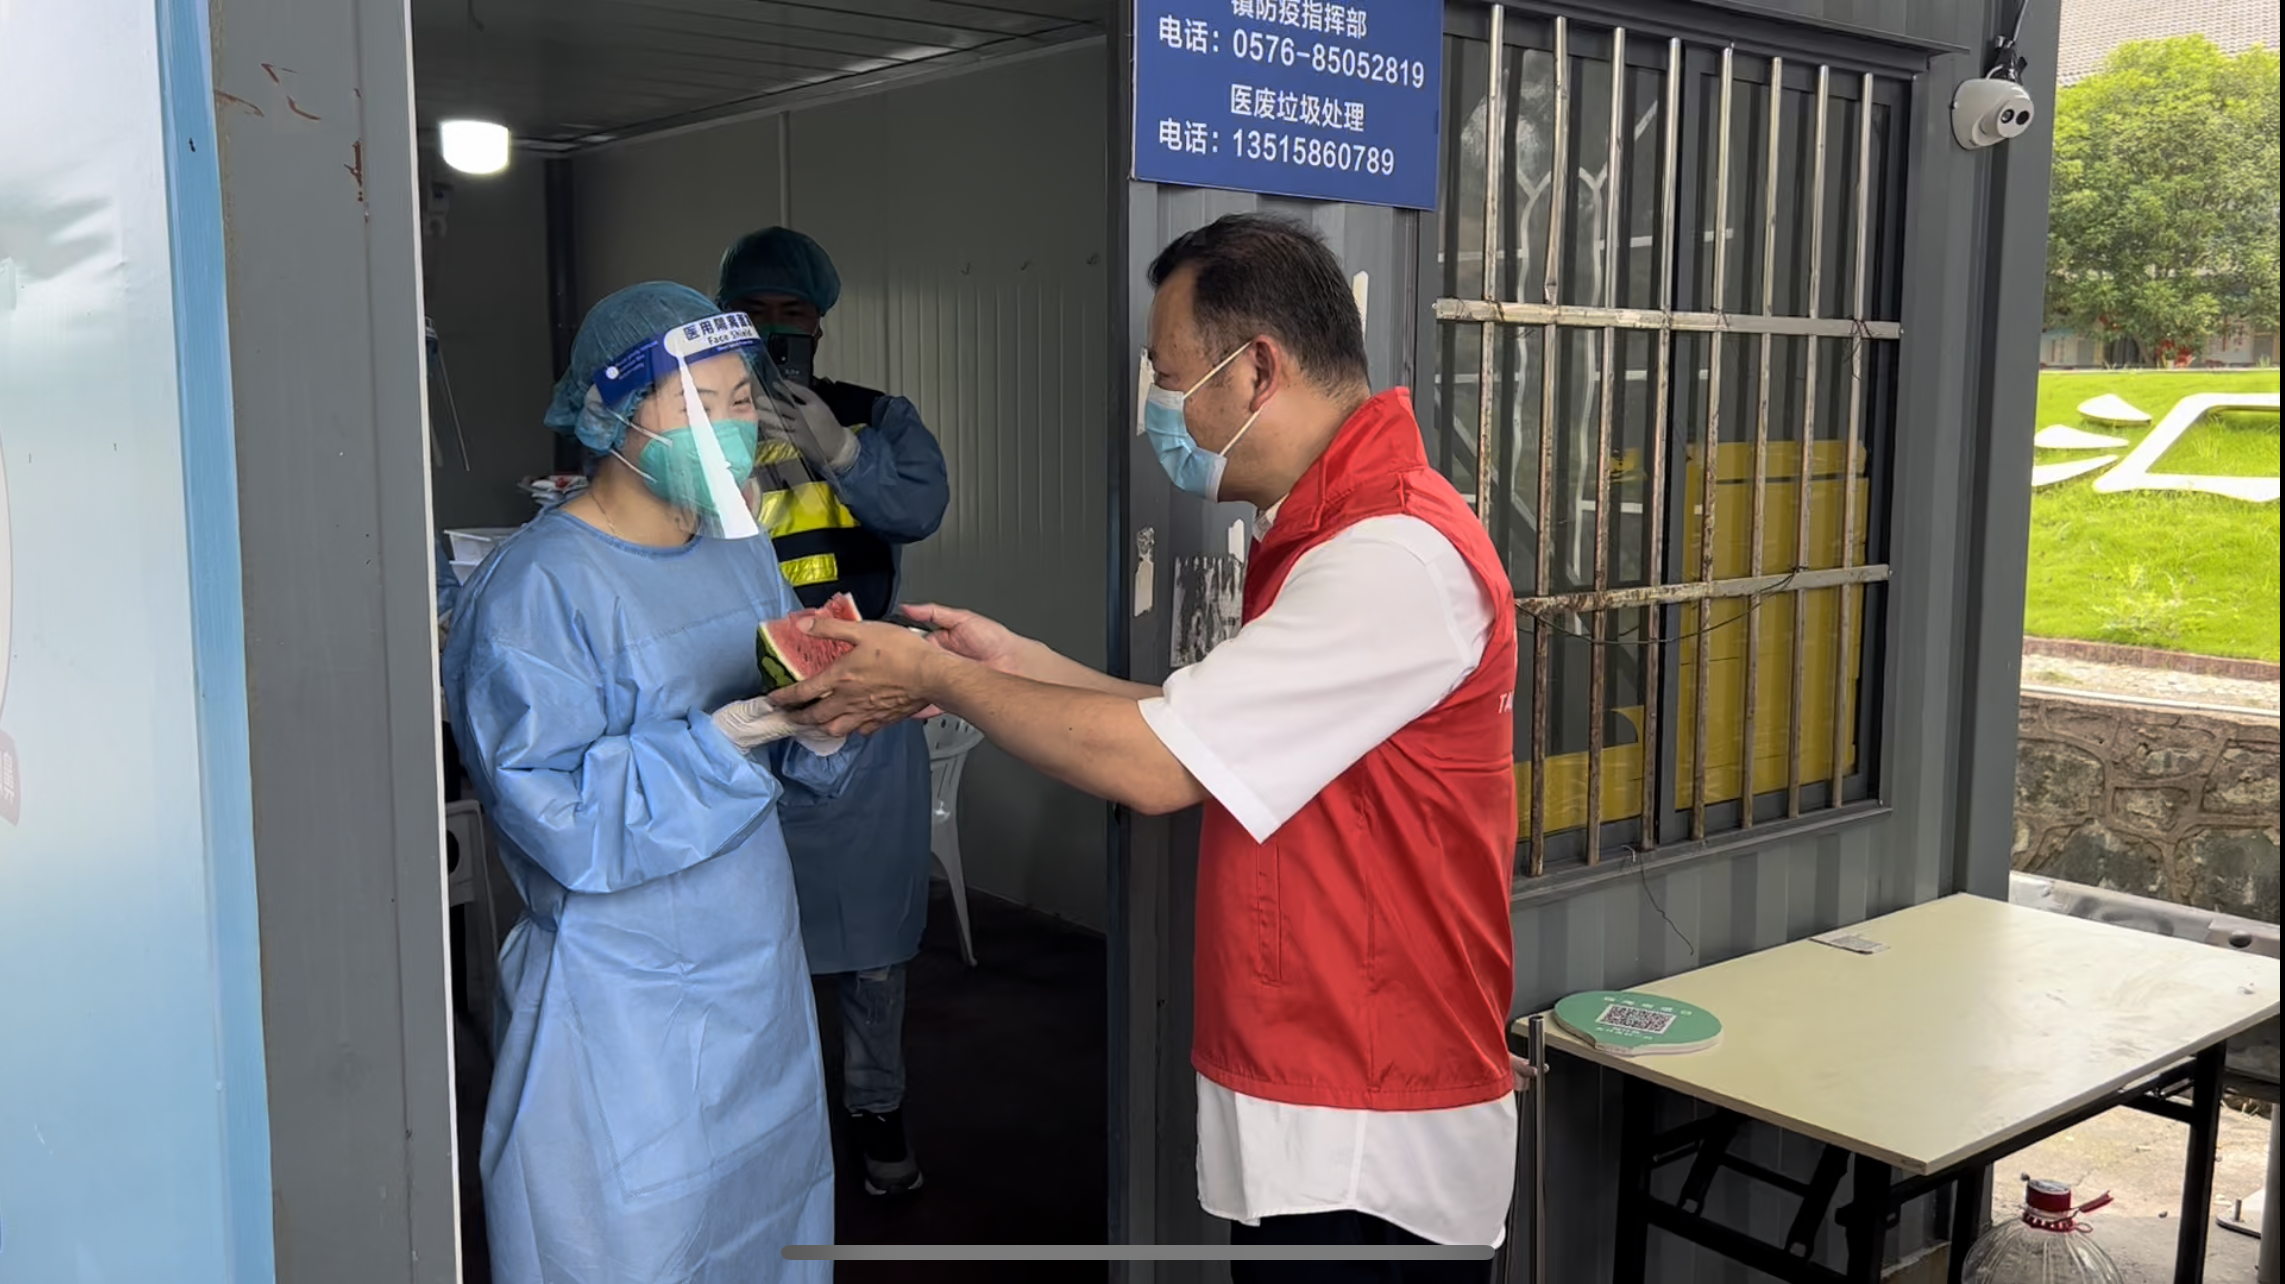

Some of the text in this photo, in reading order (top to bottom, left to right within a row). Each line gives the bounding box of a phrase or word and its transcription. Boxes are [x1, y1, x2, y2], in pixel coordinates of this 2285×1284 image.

[1231, 0, 1367, 39] 镇防疫指挥部
[1231, 83, 1364, 132] 医废垃圾处理
[708, 333, 730, 345] Face
